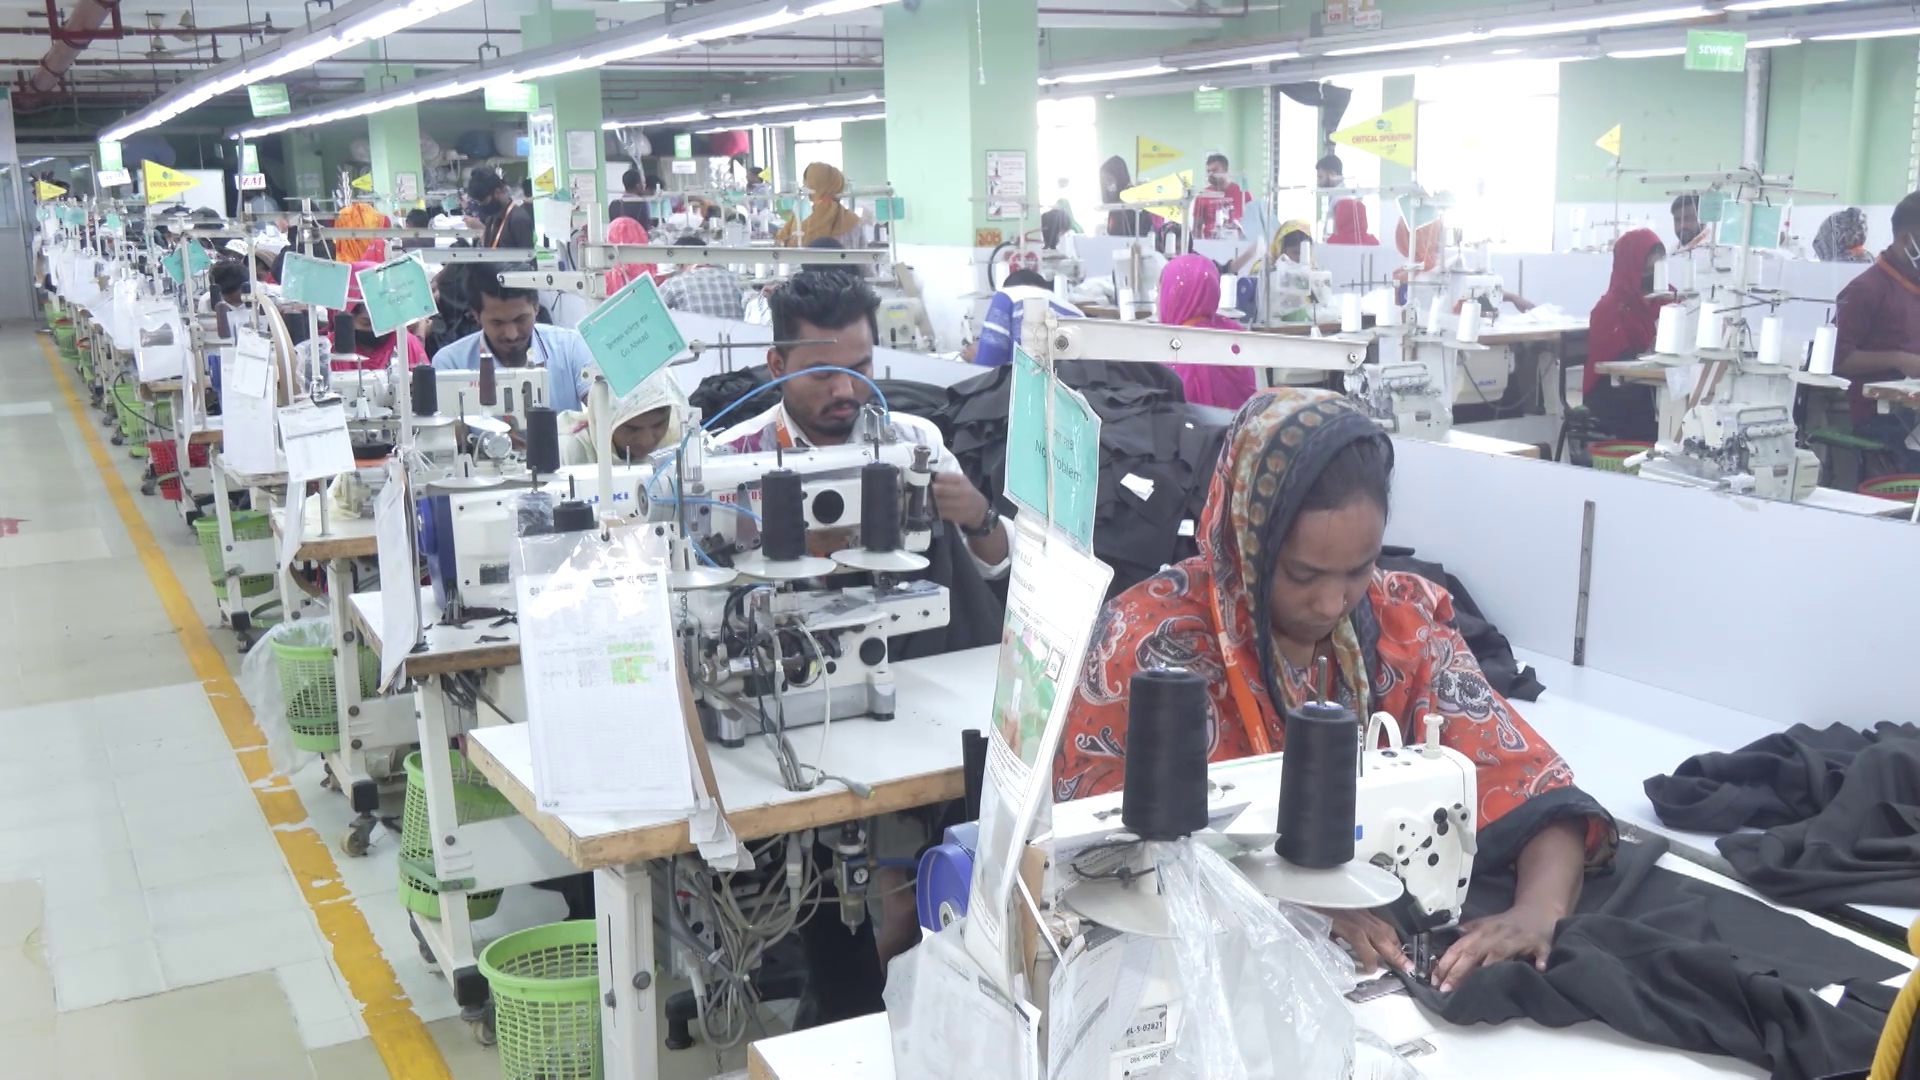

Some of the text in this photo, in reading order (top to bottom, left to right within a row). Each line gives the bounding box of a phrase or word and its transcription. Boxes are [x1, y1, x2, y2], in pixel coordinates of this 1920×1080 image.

[1698, 44, 1734, 56] SEWING
[1351, 133, 1412, 144] CRITICAL OPERATION
[620, 347, 631, 358] Go
[1051, 449, 1082, 483] roblem
[587, 491, 629, 504] JKI
